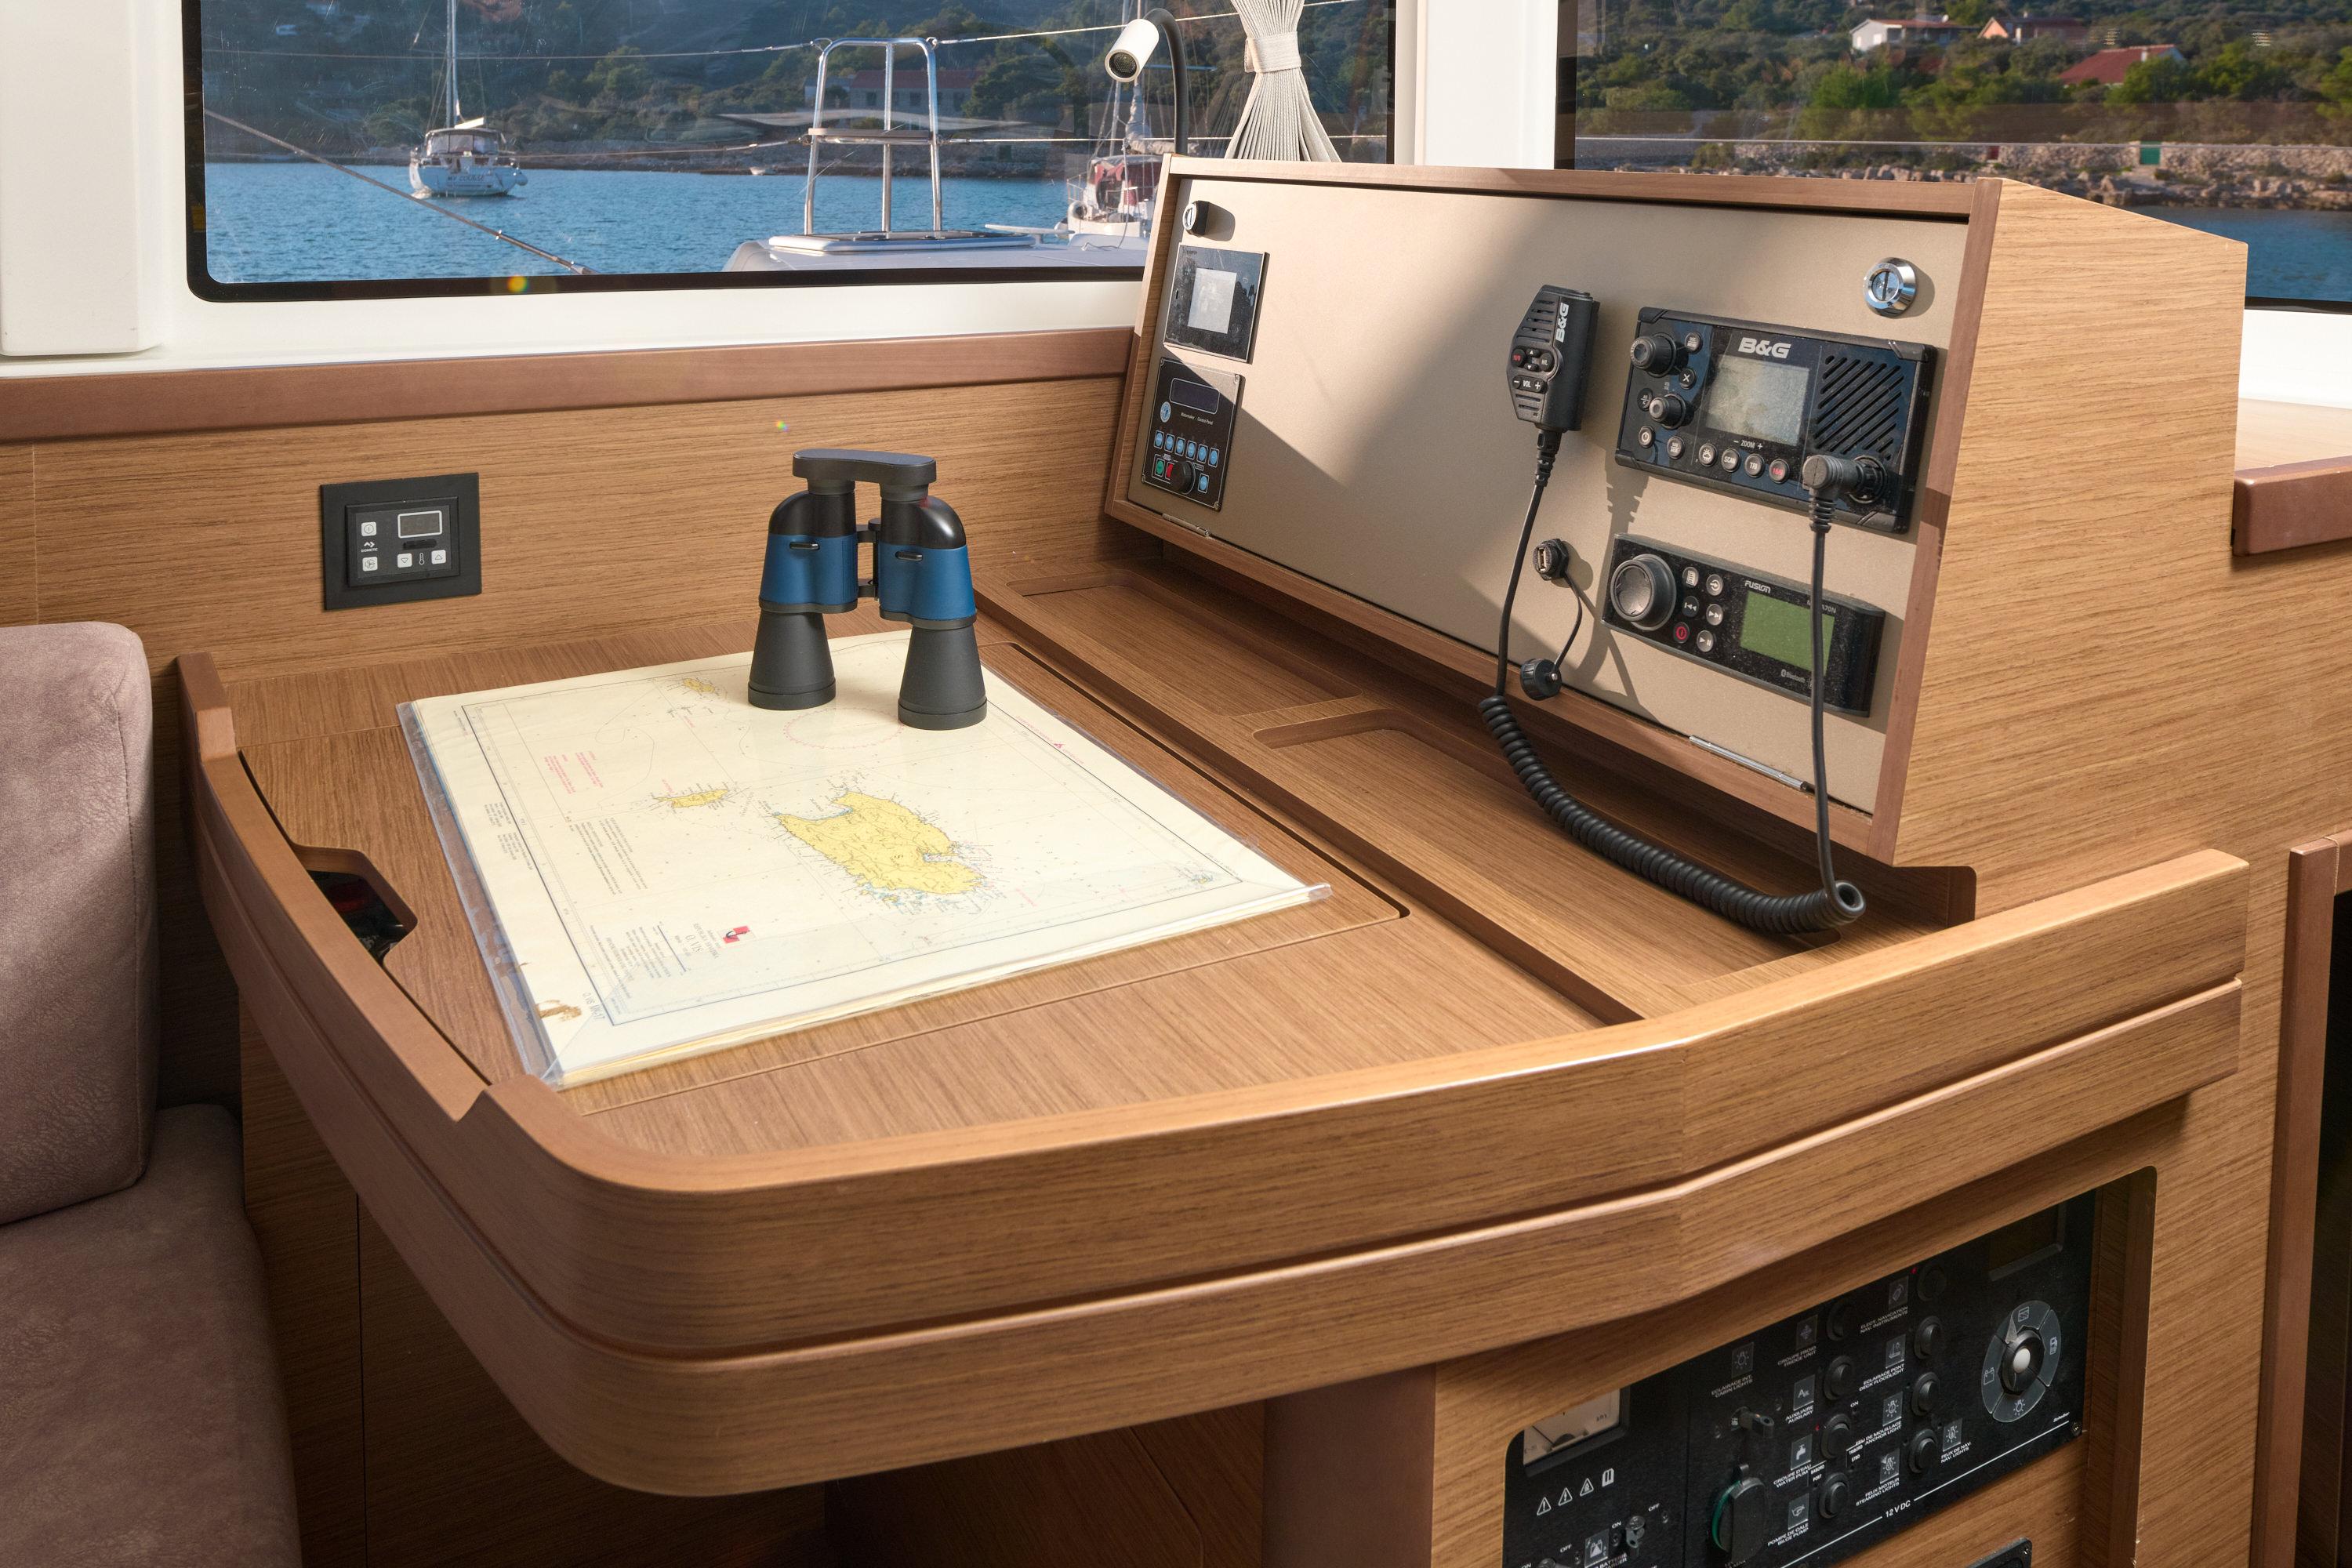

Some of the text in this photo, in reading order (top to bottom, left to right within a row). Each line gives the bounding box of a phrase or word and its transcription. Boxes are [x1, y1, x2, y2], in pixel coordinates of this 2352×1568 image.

[1555, 302, 1570, 343] B&G
[1738, 336, 1791, 359] B&G
[1523, 379, 1531, 388] VOL
[1740, 440, 1755, 449] ZOOM
[1724, 456, 1737, 465] SCAN
[1749, 462, 1759, 470] TRI
[1873, 1310, 1908, 1328] INSTRUMENTS
[1803, 1350, 1817, 1359] UNIT
[1859, 1368, 1905, 1392] DECK FLOODLIGHT
[1863, 1364, 1905, 1385] ECLAIRAGE PONT
[1715, 1379, 1753, 1398] CABIN LIGHTS
[1785, 1405, 1813, 1421] AUXILIAIRE
[1864, 1425, 1902, 1446] ANCHOR LIGHT
[1873, 1421, 1902, 1438] MOUILLAGE
[1952, 1446, 1969, 1458] LIGHTS
[1773, 1472, 1795, 1486] GROUPE
[1776, 1475, 1795, 1488] WATER
[1877, 1478, 1900, 1492] MOTEUR
[1855, 1482, 1900, 1507] STEAMING LIGHTS
[1648, 1503, 1661, 1512] OFF
[1885, 1508, 1894, 1518] 12
[1900, 1500, 1911, 1510] DC
[1767, 1532, 1787, 1547] POMPE
[1794, 1523, 1809, 1534] CALE
[1777, 1526, 1809, 1546] BILGE PUMP
[1559, 1543, 1573, 1553] OFF
